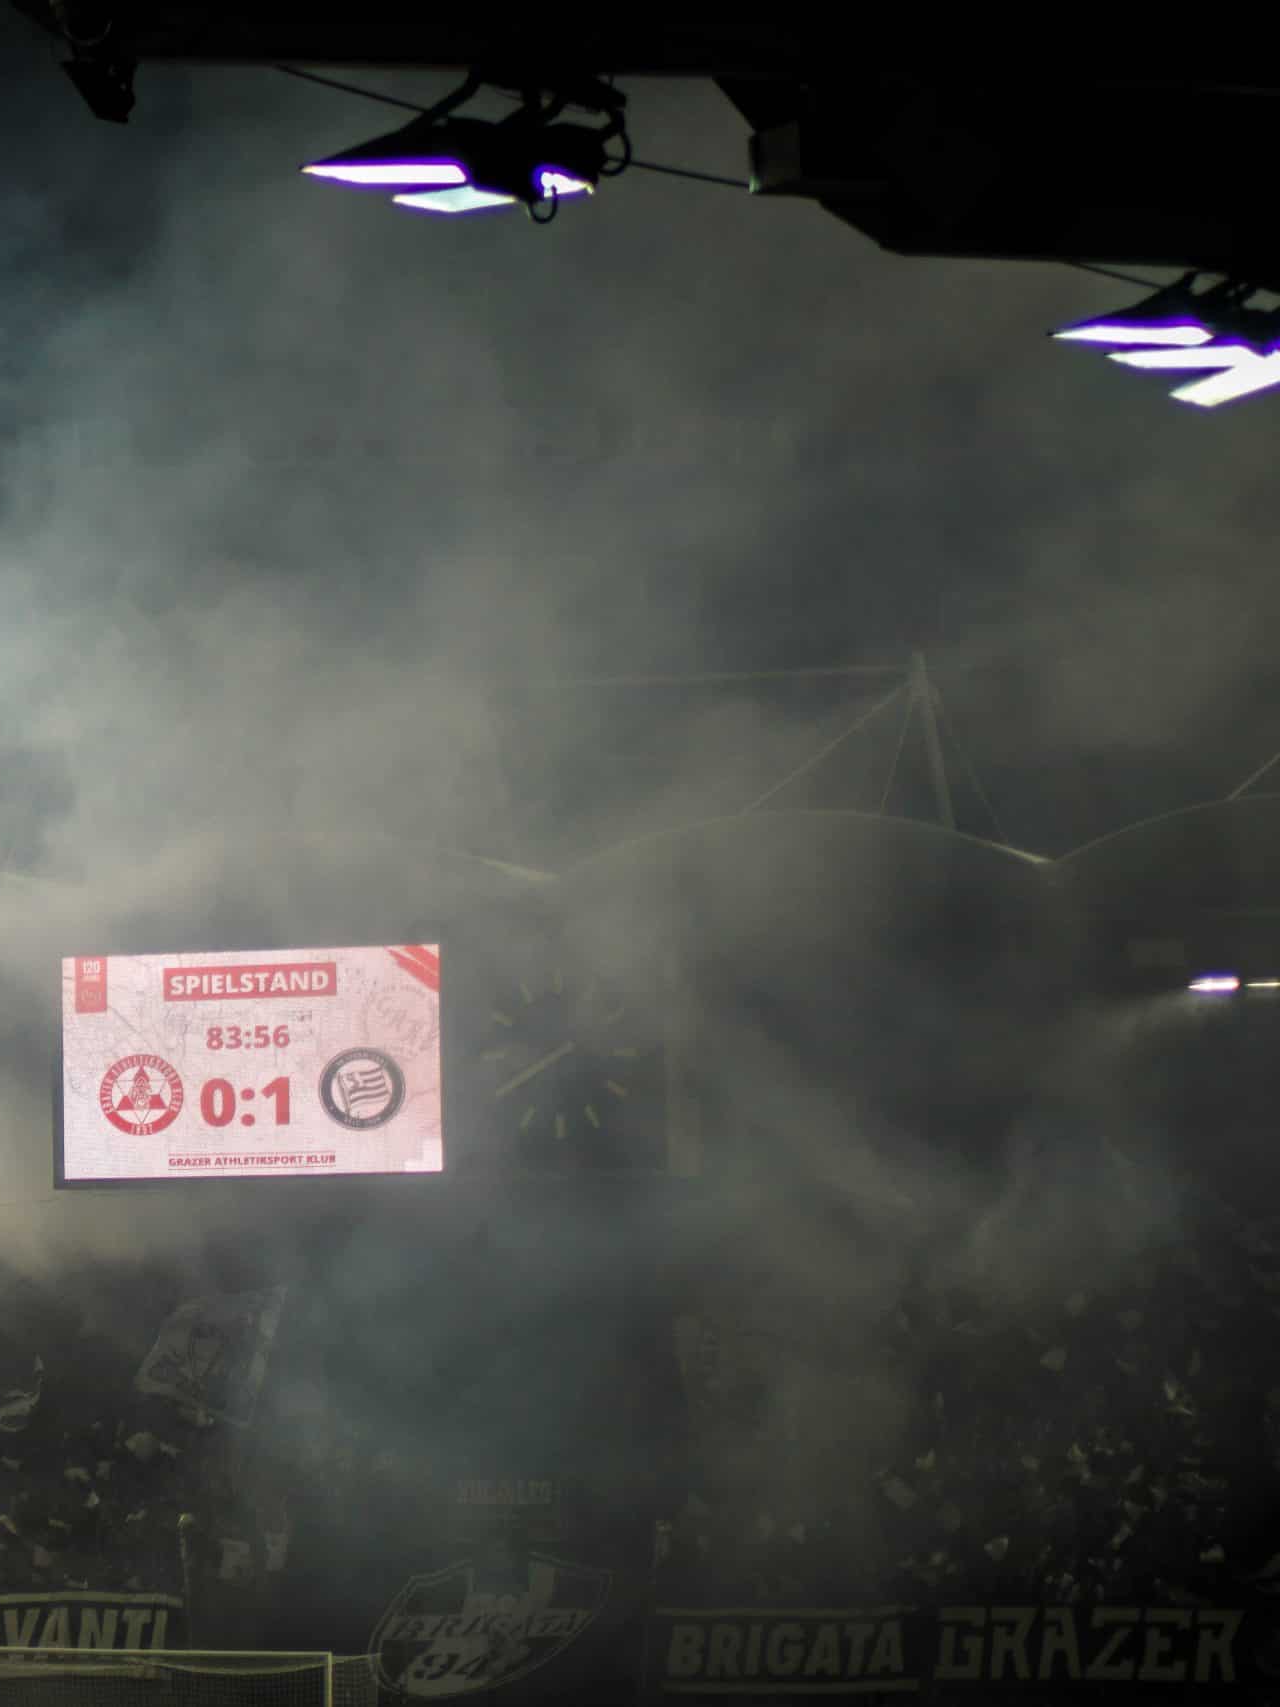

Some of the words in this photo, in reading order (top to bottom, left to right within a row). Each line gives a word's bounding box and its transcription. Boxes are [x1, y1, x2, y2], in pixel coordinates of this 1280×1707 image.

[170, 970, 329, 996] SPIELSTAND
[205, 1025, 291, 1050] 83:56
[199, 1076, 291, 1128] 0:1
[168, 1157, 211, 1167] GRAZER
[214, 1155, 304, 1166] ATHLETIKSPORT
[305, 1154, 337, 1165] KLUB
[666, 1618, 908, 1679] BRIGATA
[932, 1604, 1250, 1683] GRAZER
